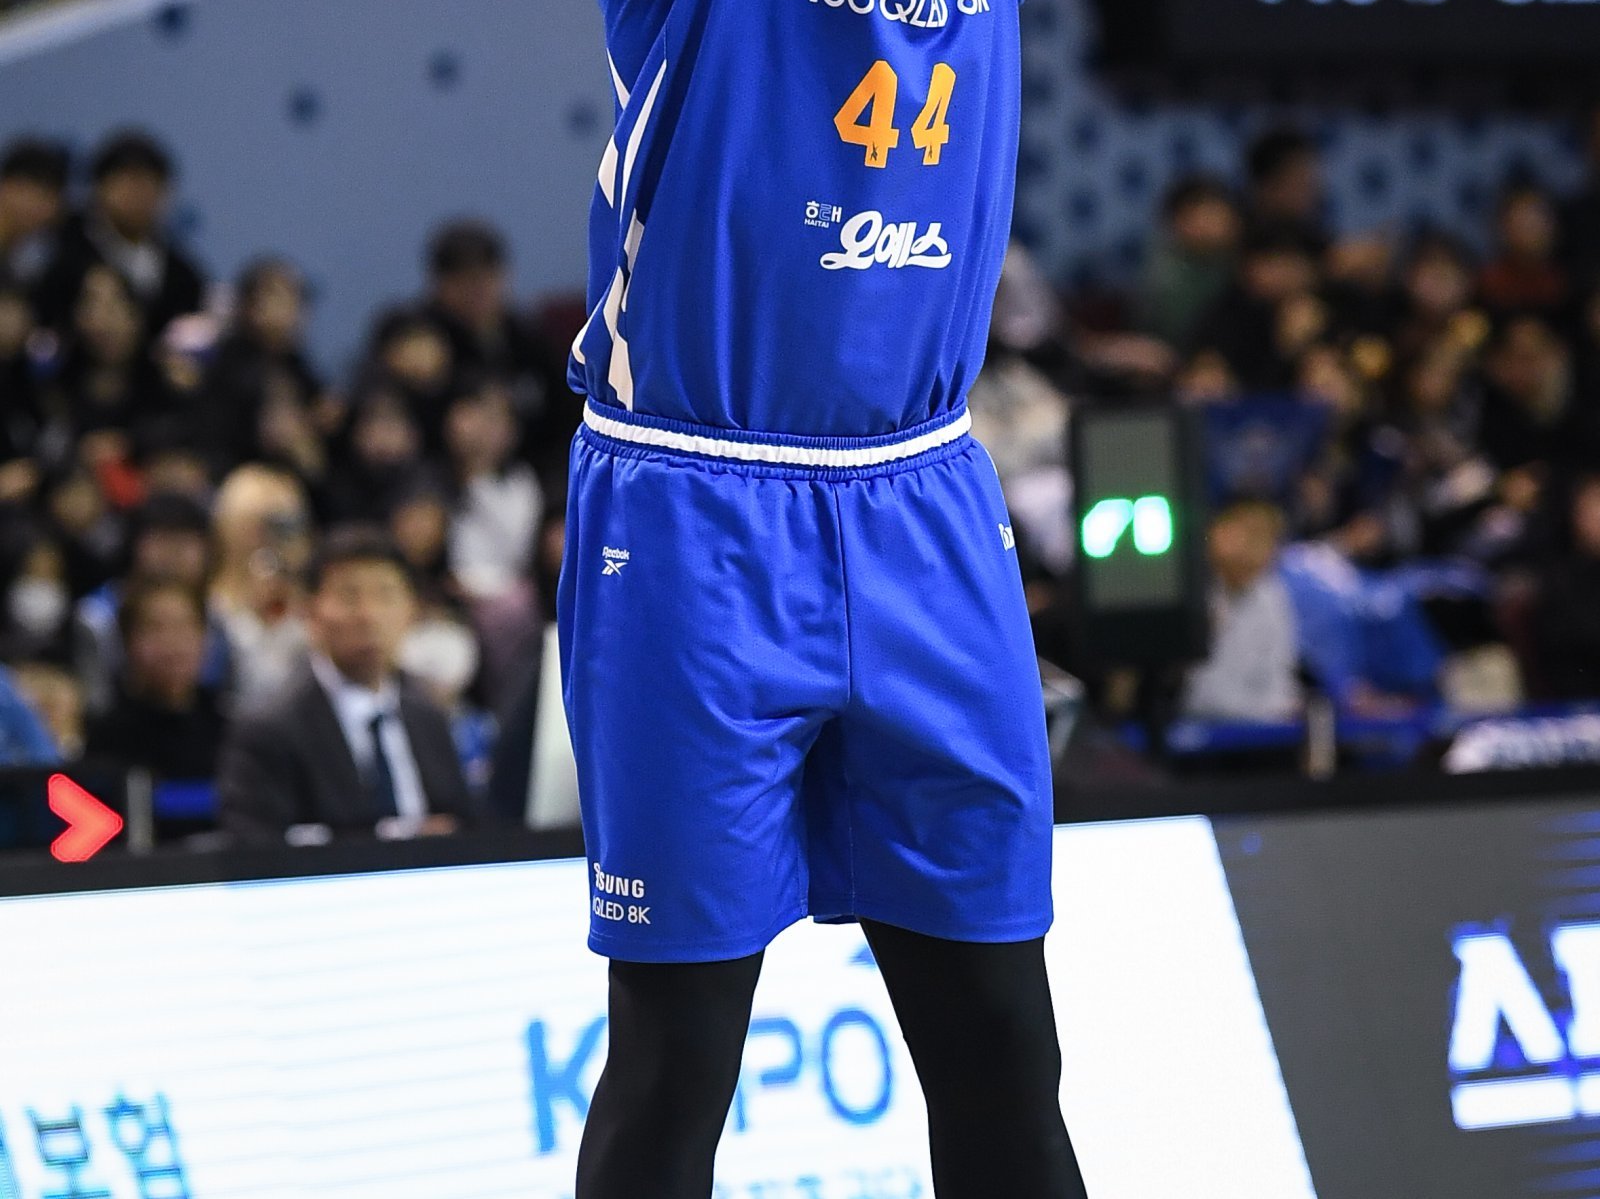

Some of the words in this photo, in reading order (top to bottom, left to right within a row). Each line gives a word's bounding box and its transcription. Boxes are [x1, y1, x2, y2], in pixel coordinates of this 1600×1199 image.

[833, 60, 957, 169] 44
[804, 218, 830, 229] HAITAI
[820, 210, 952, 270] 오예스
[627, 905, 652, 925] 8K
[527, 1006, 893, 1155] KPO
